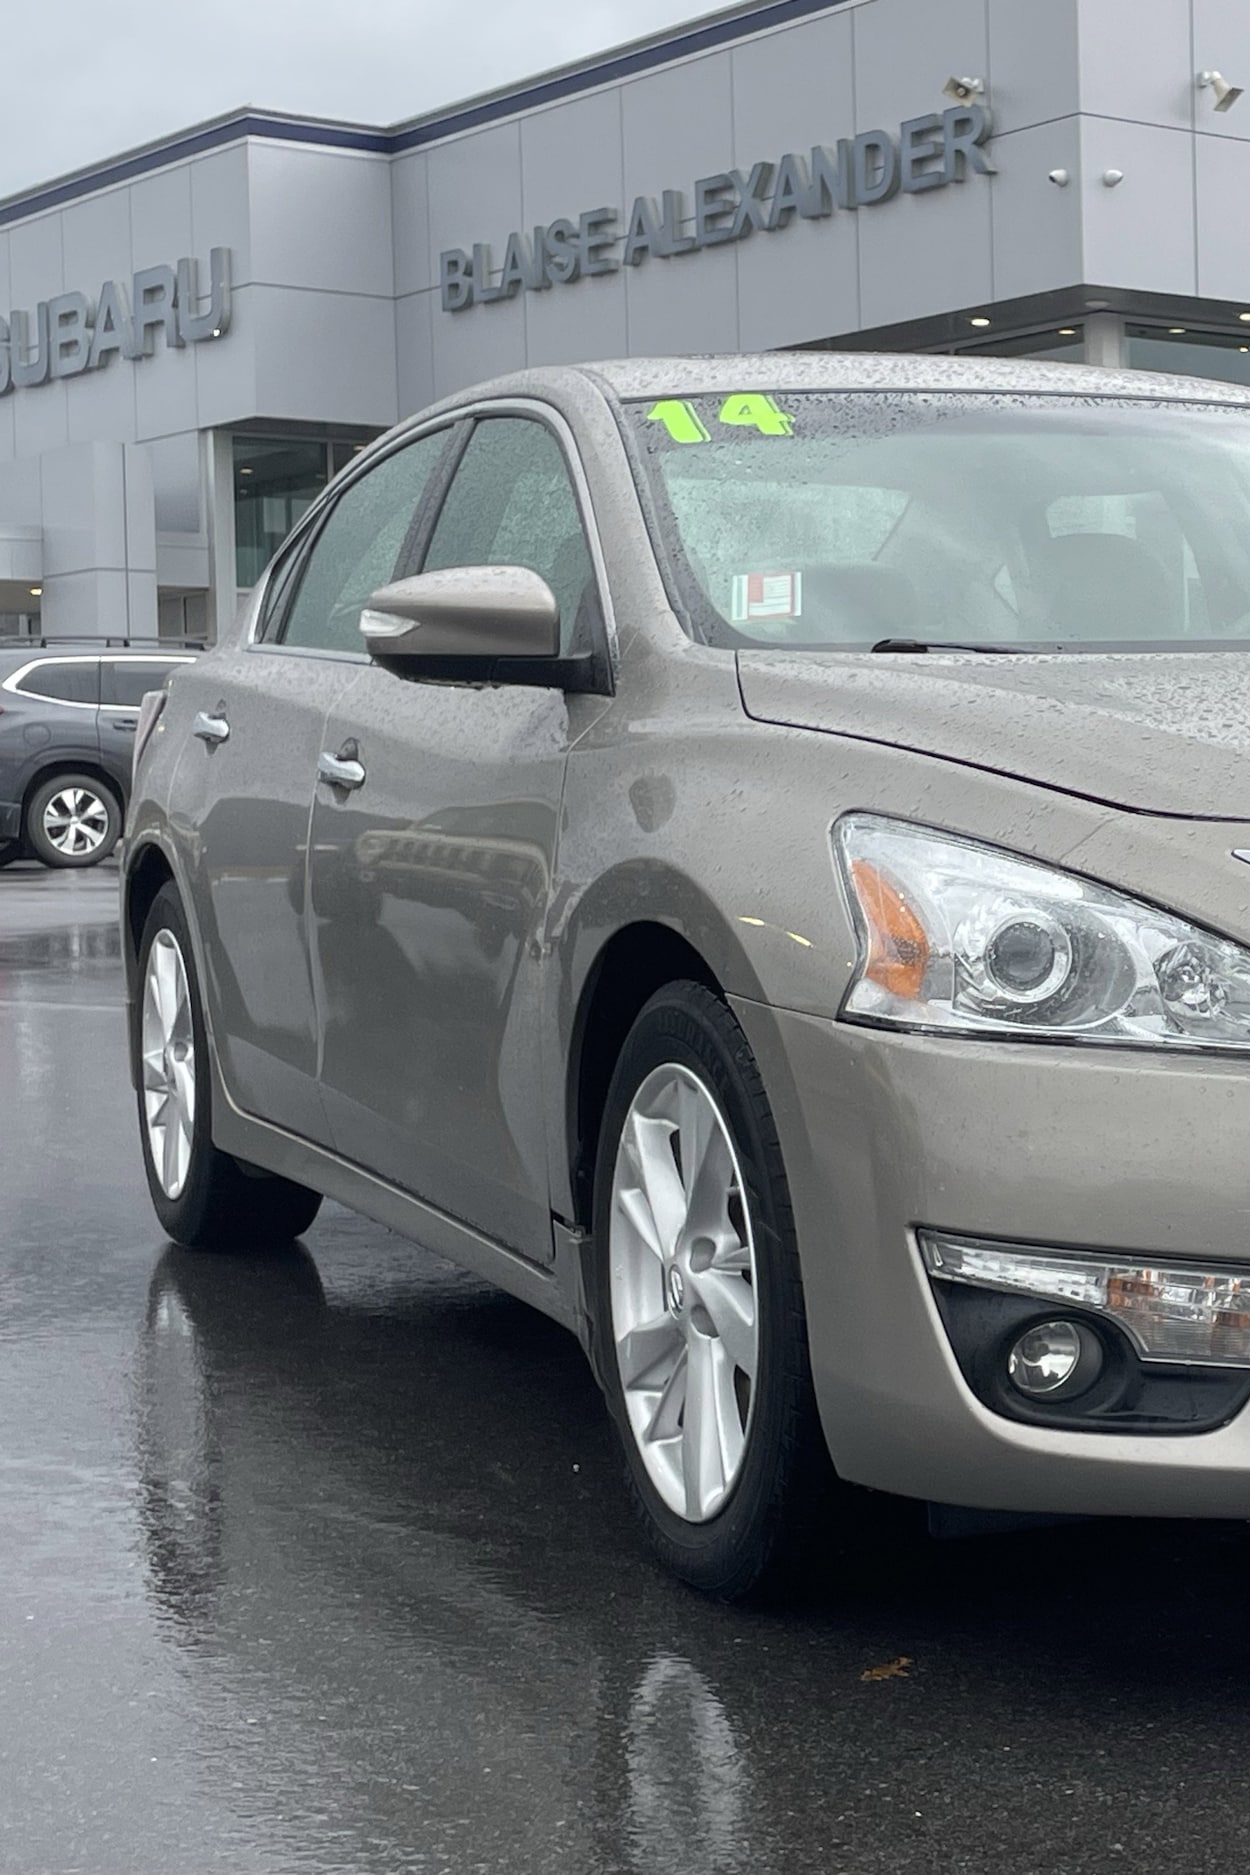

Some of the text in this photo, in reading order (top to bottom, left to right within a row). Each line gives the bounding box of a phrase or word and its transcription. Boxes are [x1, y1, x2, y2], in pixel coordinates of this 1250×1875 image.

[439, 104, 997, 312] BLAISE ALEXANDER
[0, 247, 232, 396] UBARU
[646, 393, 796, 443] 14
